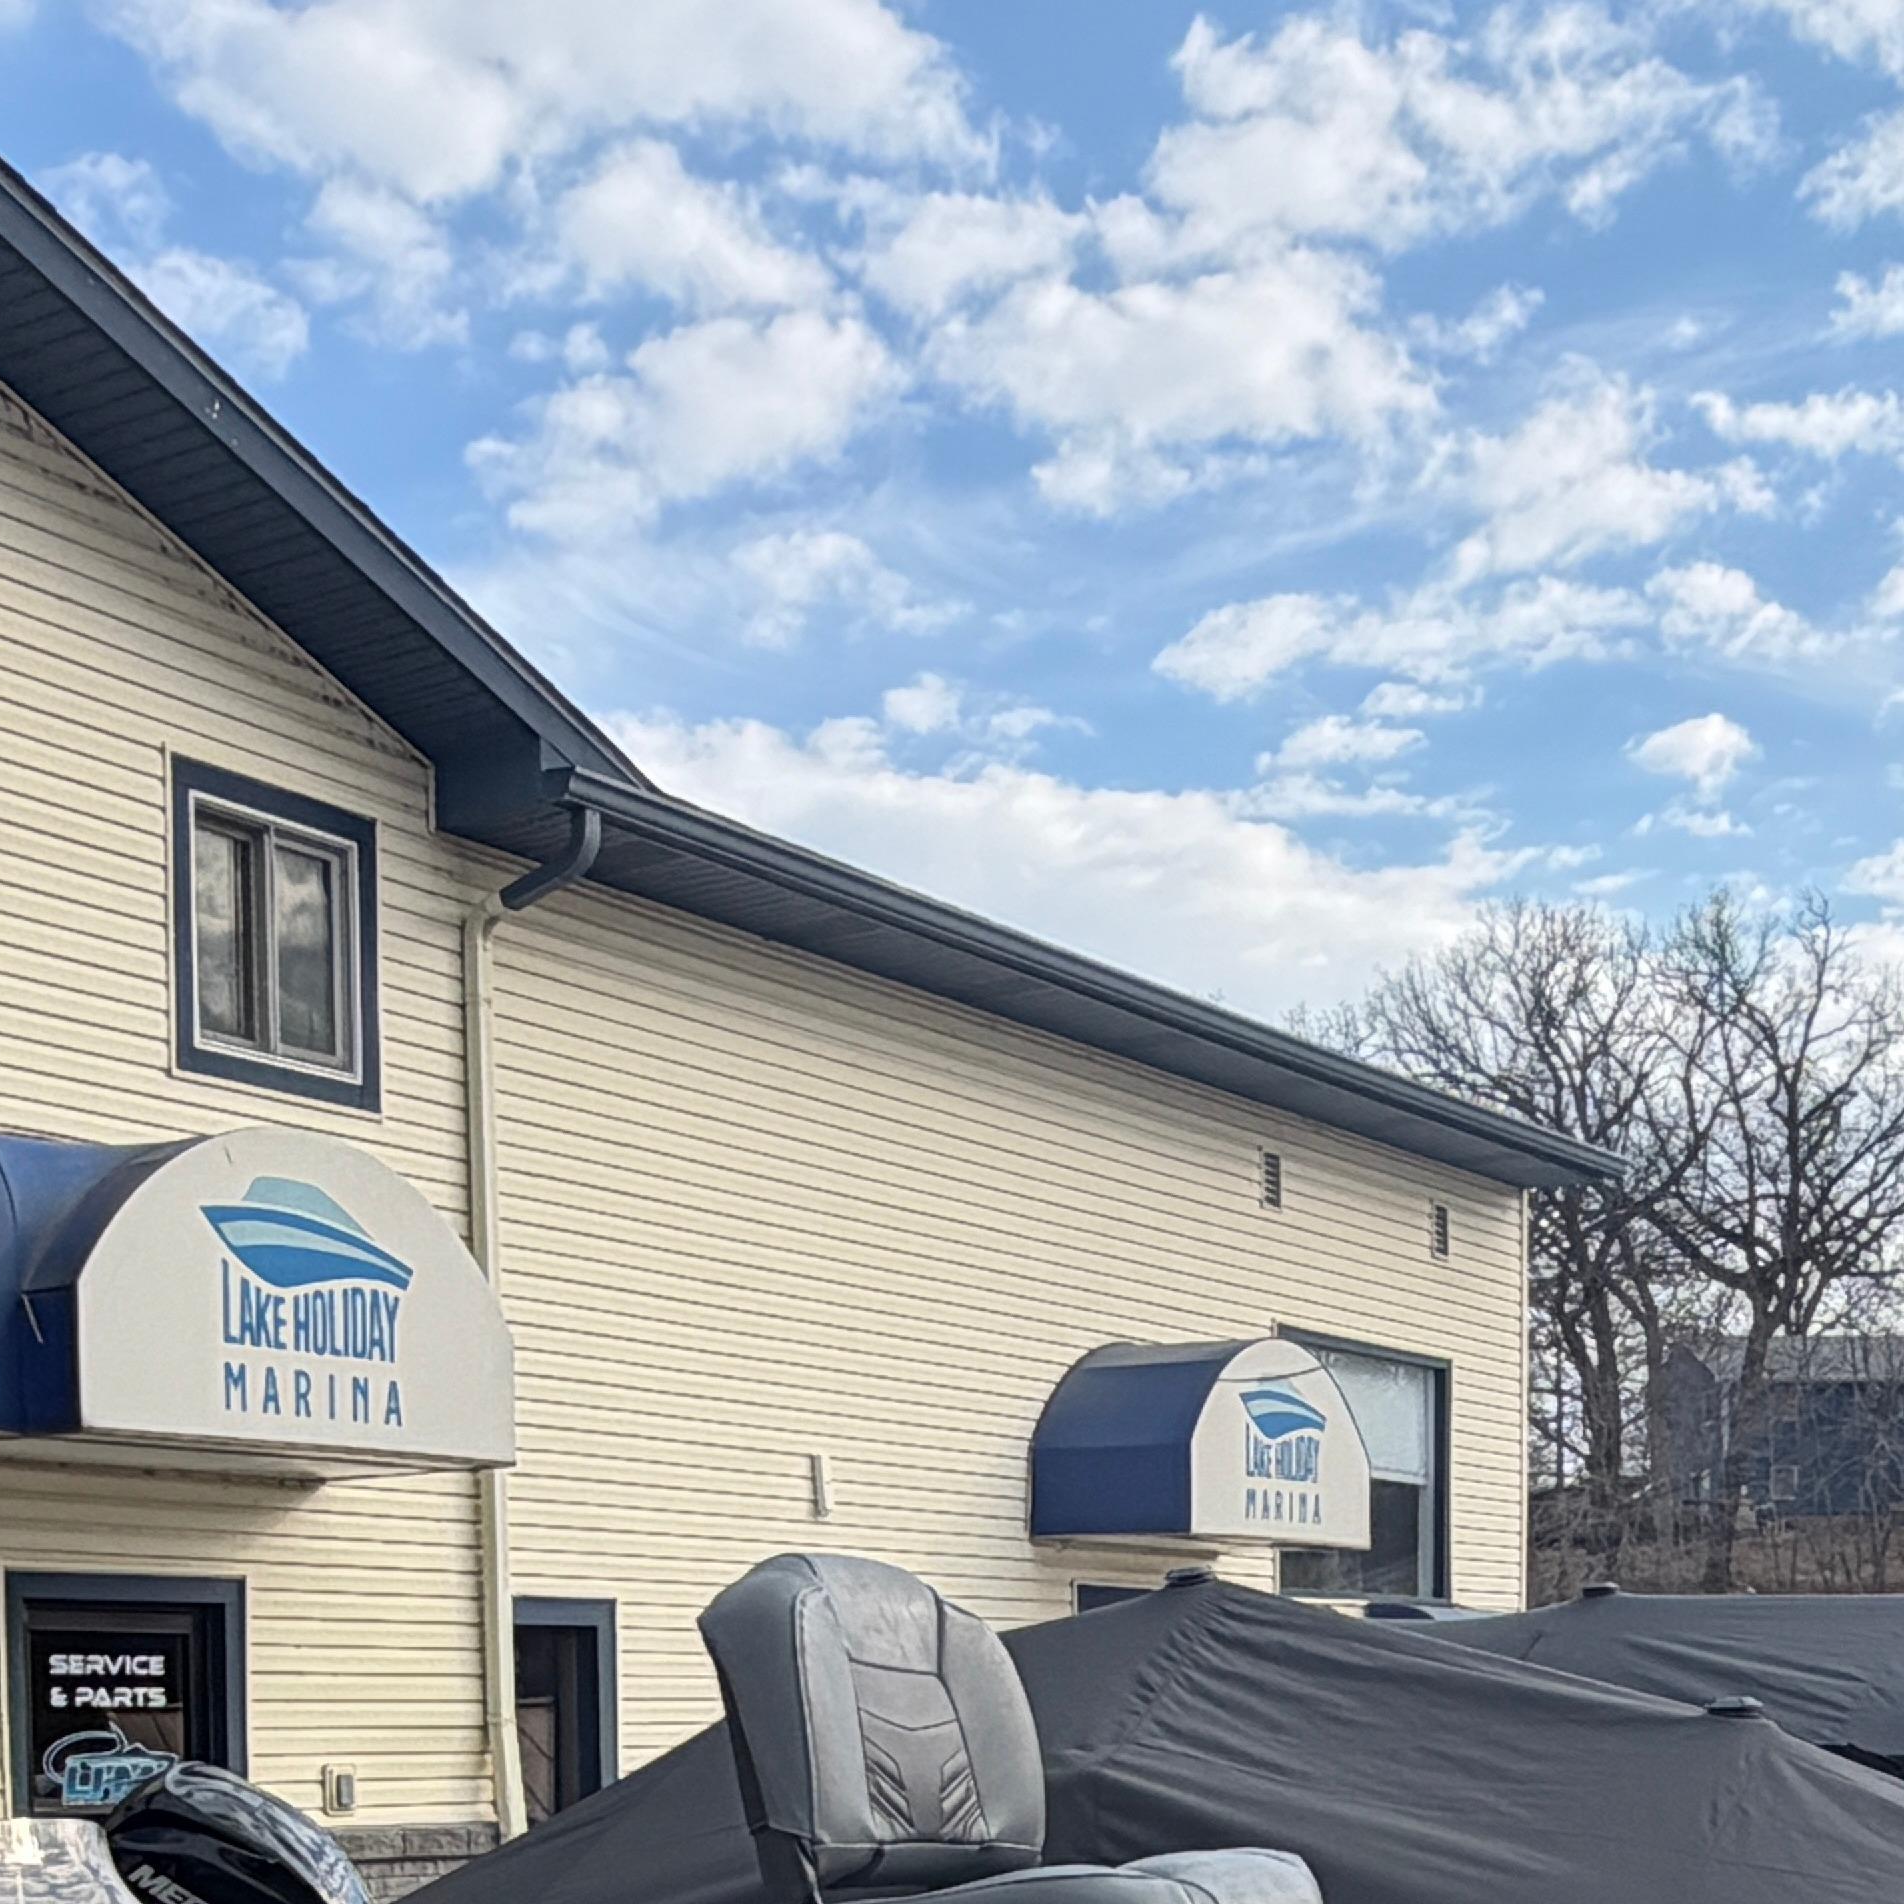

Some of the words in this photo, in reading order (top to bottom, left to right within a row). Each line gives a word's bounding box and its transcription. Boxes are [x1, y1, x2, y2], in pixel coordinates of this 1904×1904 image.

[222, 1259, 287, 1350] LAKE
[293, 1286, 400, 1363] HOLIDAY
[224, 1362, 403, 1428] MARINA
[48, 1654, 166, 1676] SERVICE
[50, 1686, 68, 1708] &
[75, 1686, 167, 1708] PARTS
